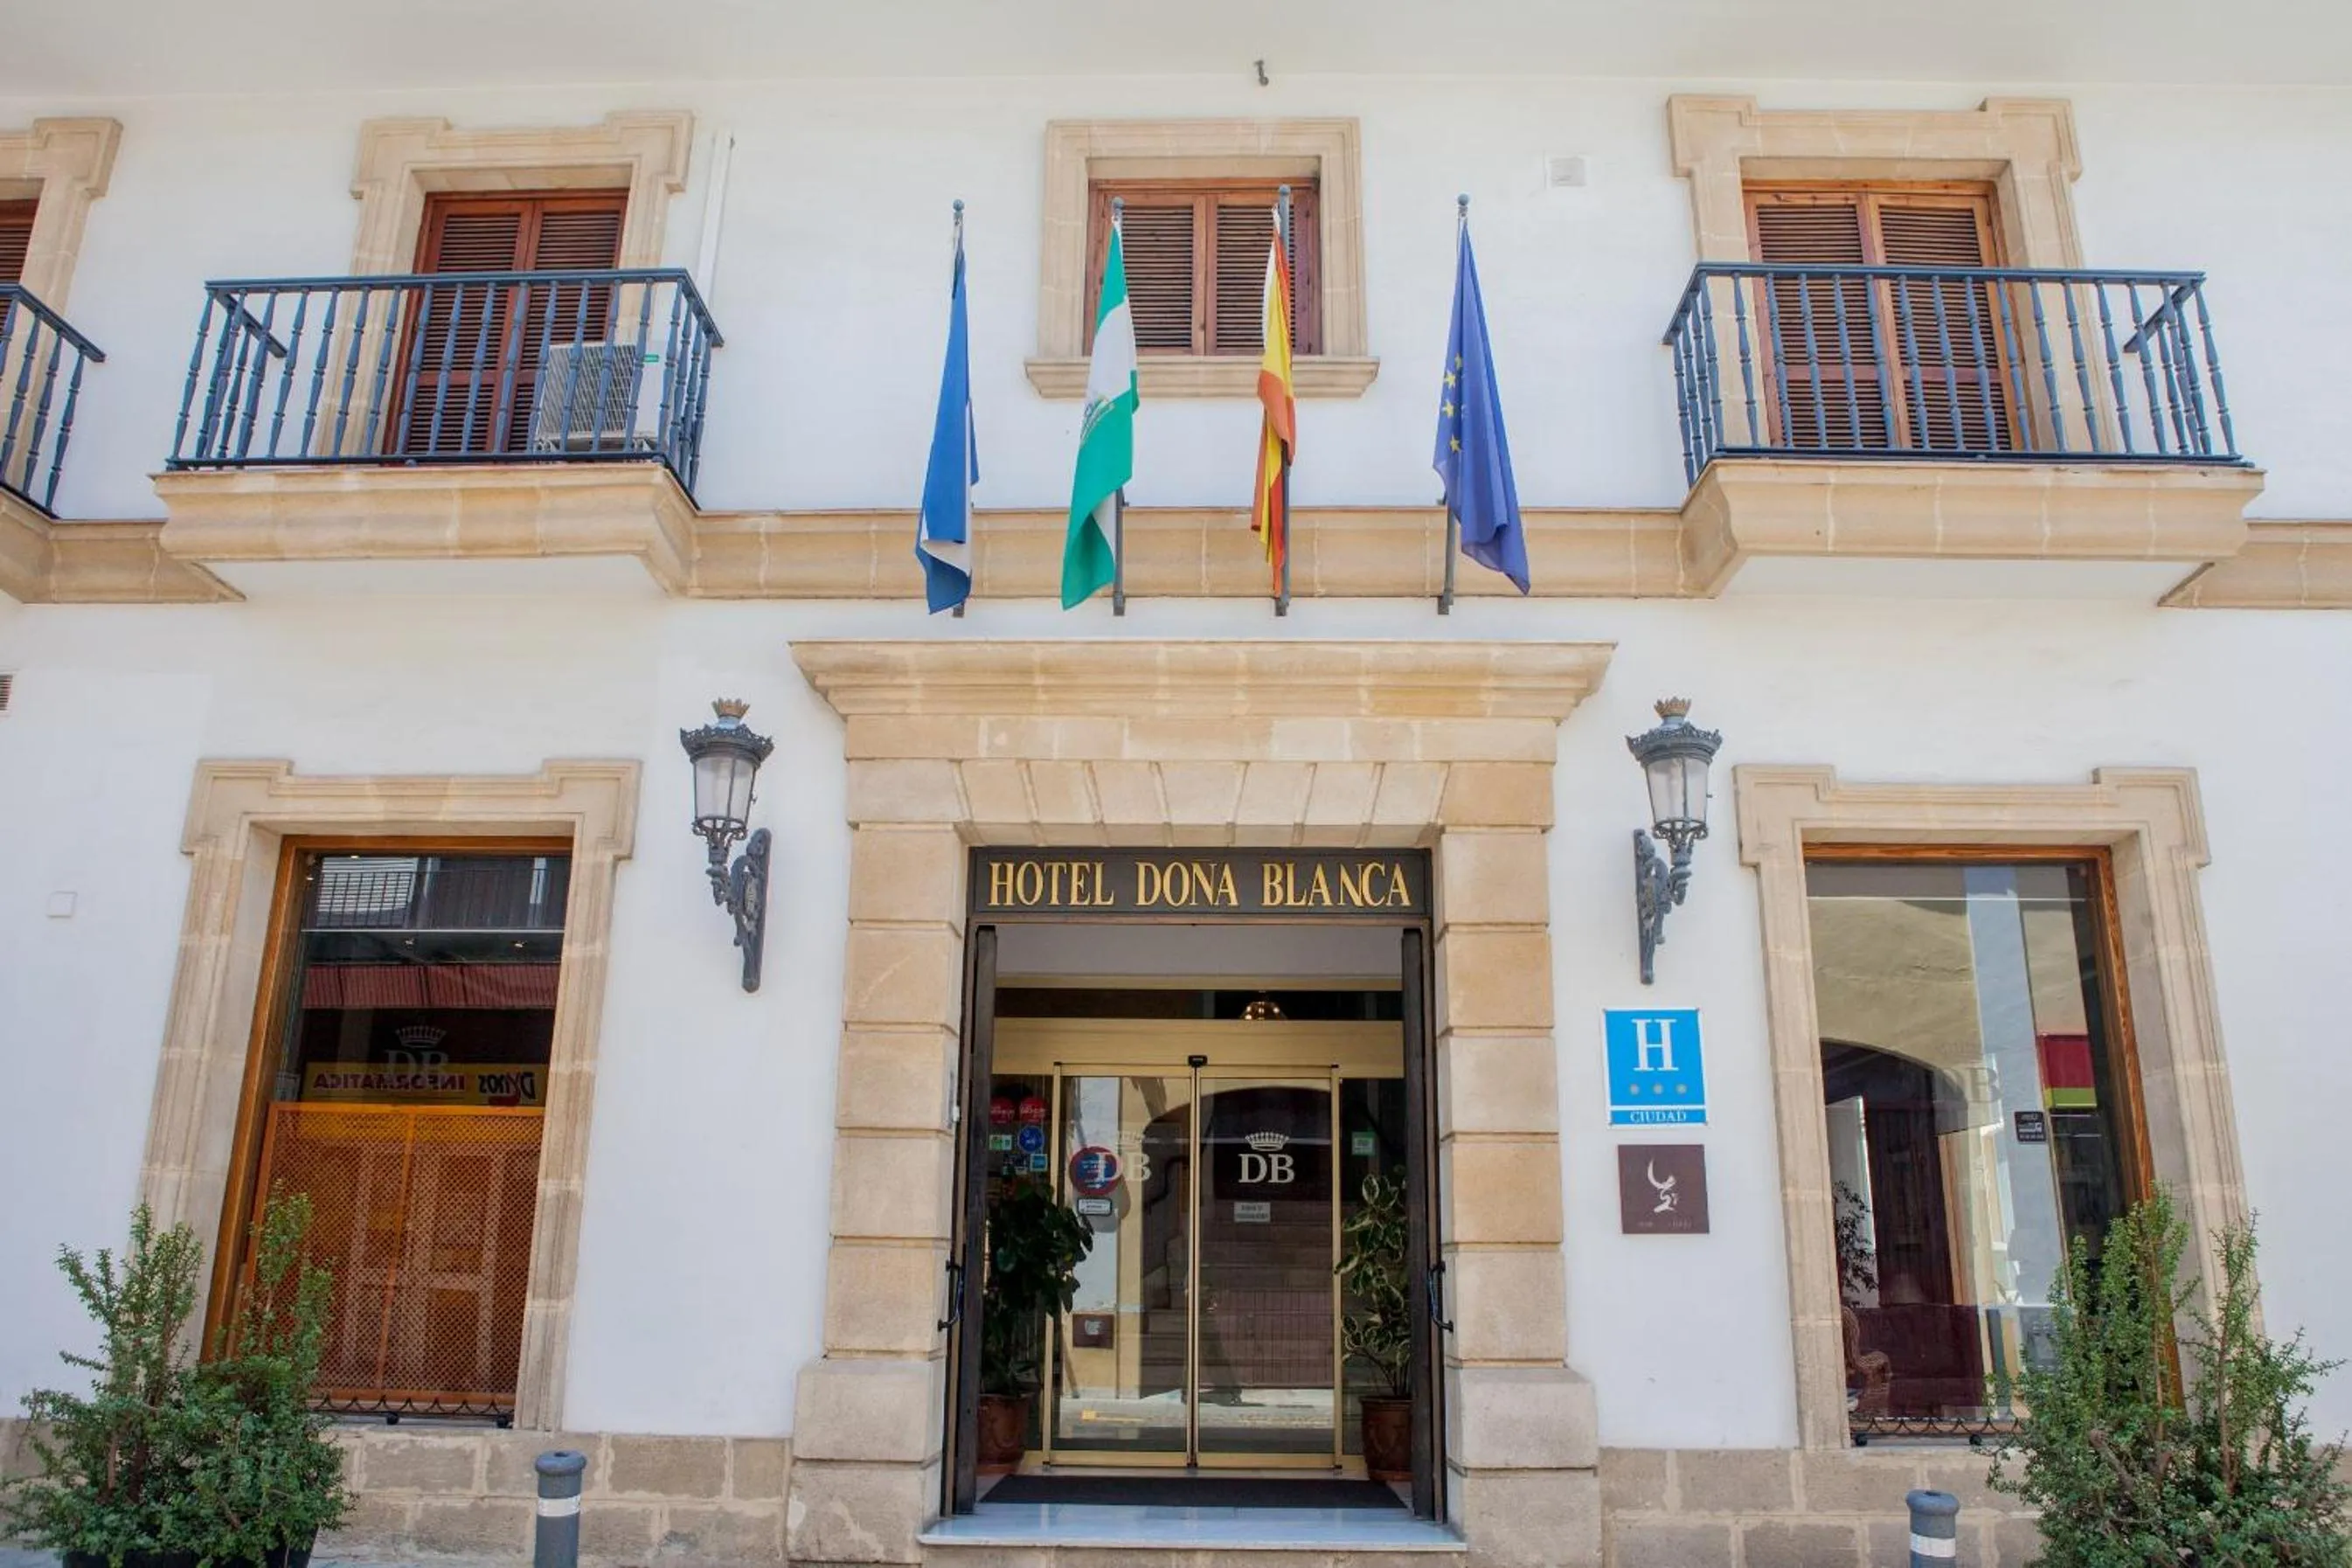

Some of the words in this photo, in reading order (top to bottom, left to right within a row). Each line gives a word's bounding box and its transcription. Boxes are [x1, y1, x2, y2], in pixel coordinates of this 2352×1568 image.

[988, 861, 1114, 906] HOTEL
[1261, 861, 1412, 907] BLANCA
[1631, 1018, 1679, 1072] H
[1629, 1111, 1687, 1123] CIUDAD
[1238, 1154, 1295, 1183] DB
